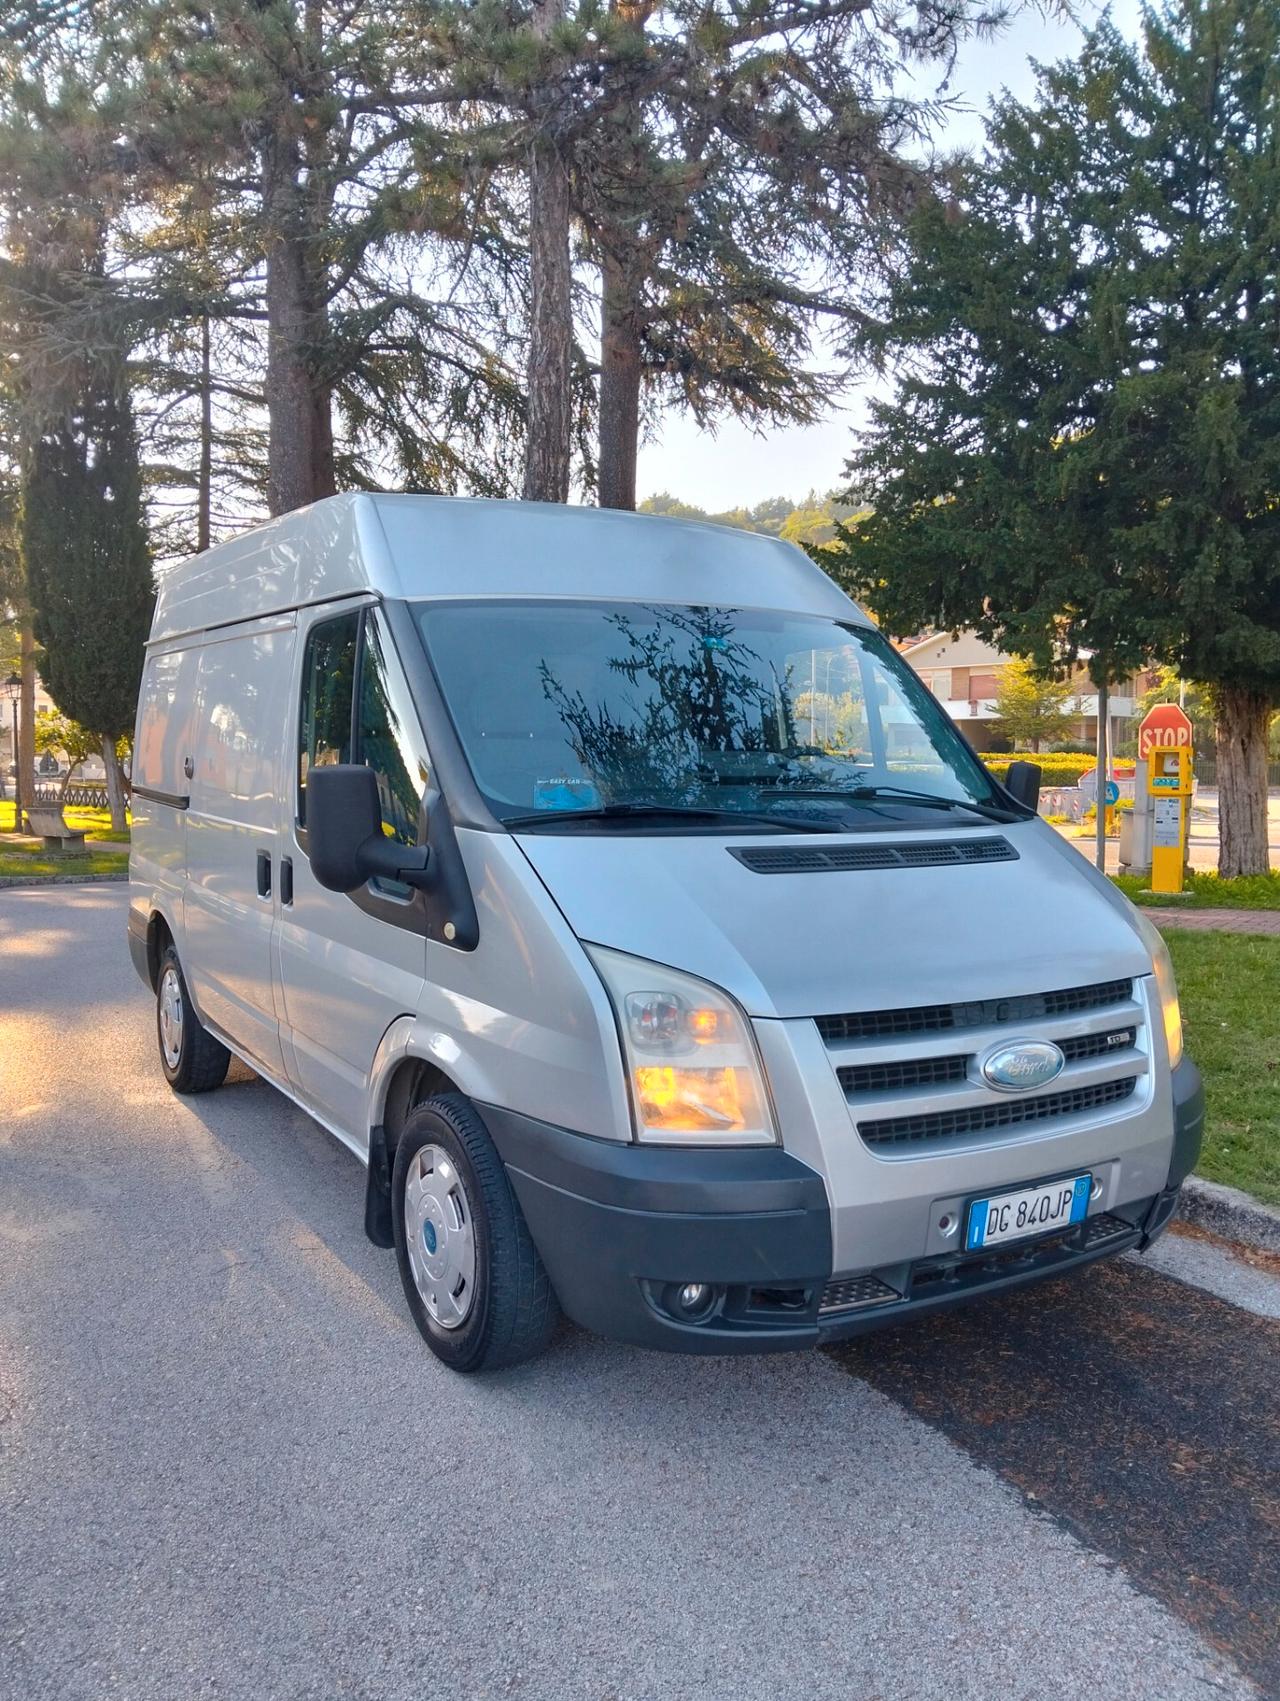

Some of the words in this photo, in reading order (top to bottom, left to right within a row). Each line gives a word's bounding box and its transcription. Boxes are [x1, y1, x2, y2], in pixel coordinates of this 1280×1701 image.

[1142, 727, 1188, 754] STOP
[987, 1205, 1011, 1236] DG
[1016, 1189, 1073, 1228] 840JP
